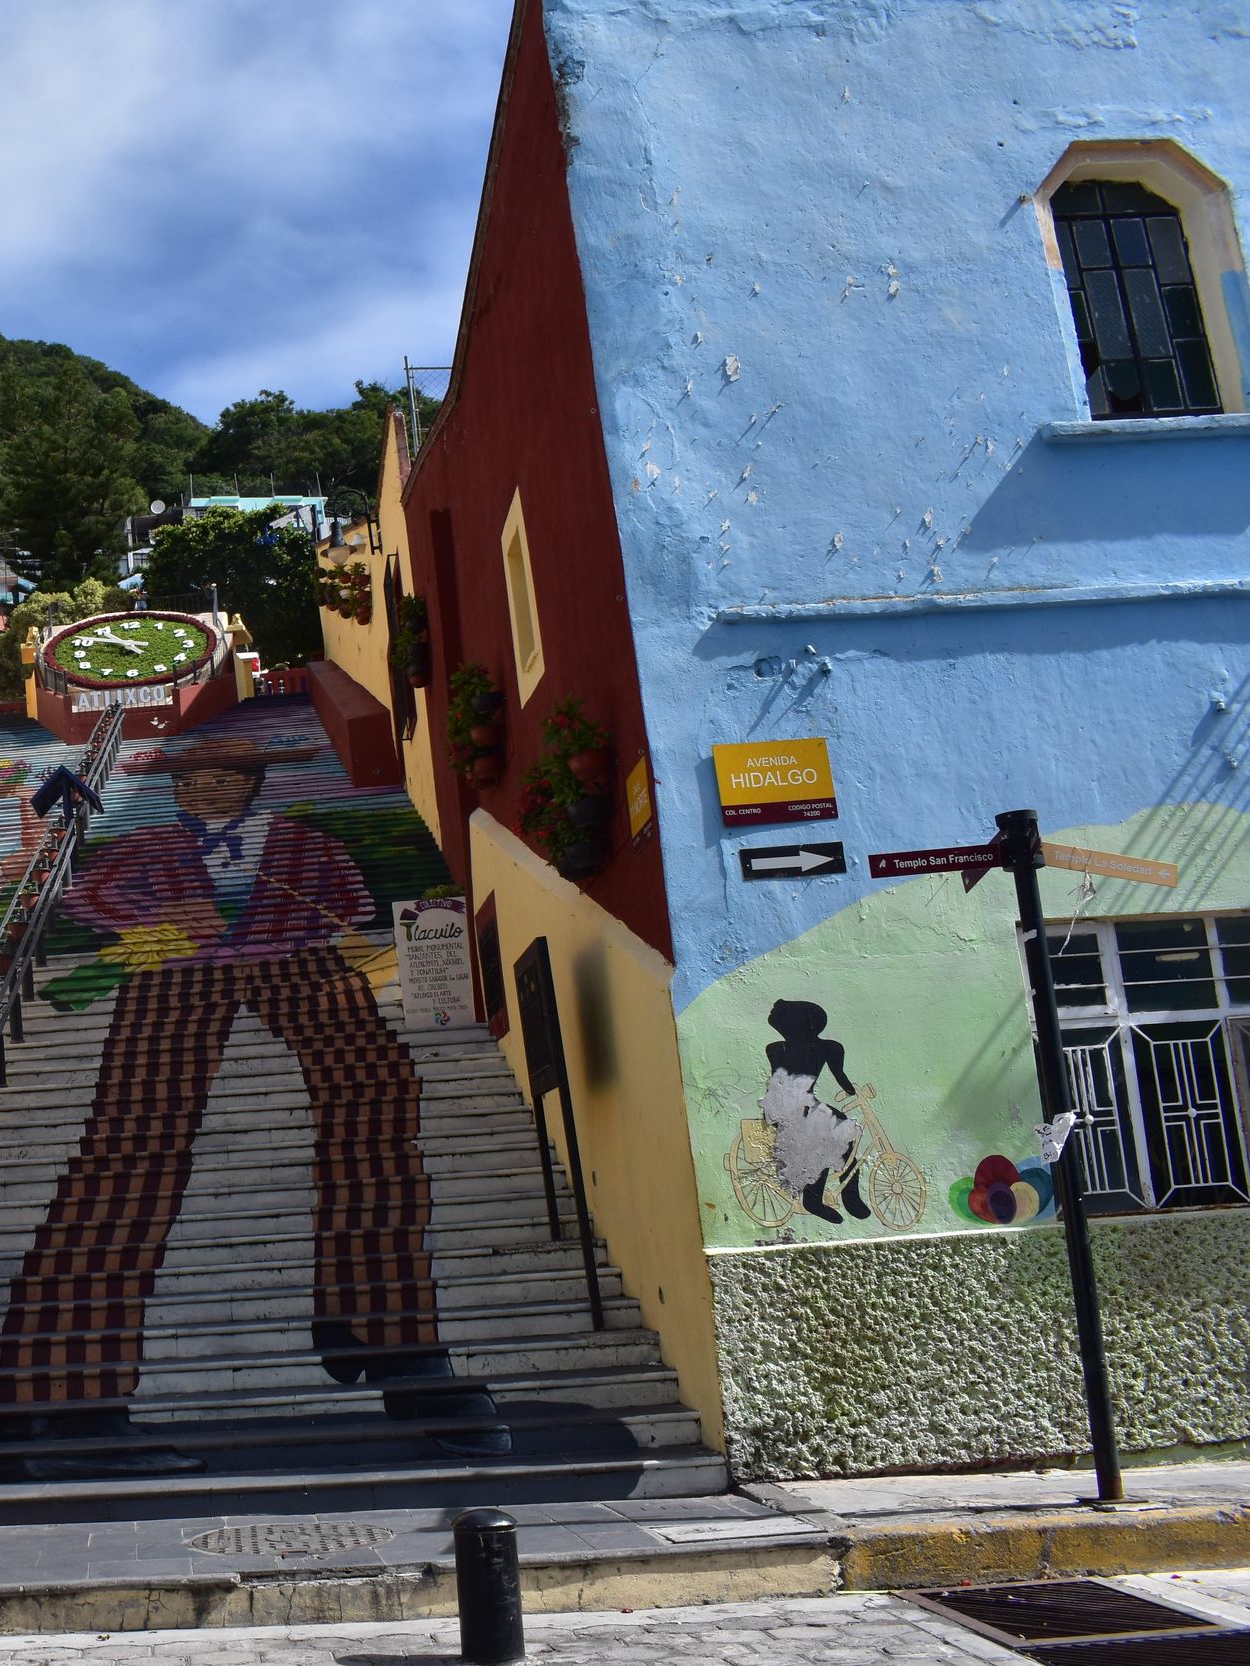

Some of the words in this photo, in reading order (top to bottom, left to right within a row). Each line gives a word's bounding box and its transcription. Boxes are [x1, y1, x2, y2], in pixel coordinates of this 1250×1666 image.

[120, 621, 141, 629] 12
[154, 622, 164, 630] 1
[93, 626, 111, 636] 11
[173, 629, 187, 638] 2
[71, 639, 94, 647] 10
[182, 639, 195, 648] 3
[73, 650, 86, 659] 9
[173, 652, 187, 661] 4
[78, 661, 92, 670] 8
[153, 664, 167, 672] 5
[100, 668, 113, 676] 7
[126, 669, 139, 677] 6
[77, 685, 166, 711] ATLIXCO
[746, 755, 798, 768] AVENIDA
[730, 768, 818, 789] HIDALGO
[893, 857, 927, 869] Templo
[929, 856, 947, 866] San
[949, 852, 994, 864] Francisco
[1053, 851, 1092, 865] Templo
[1094, 857, 1107, 868] La
[1109, 860, 1152, 875] Soledad
[419, 899, 453, 910] COLECTIVO
[399, 921, 464, 942] Tlacuilo
[446, 950, 459, 958] DEL
